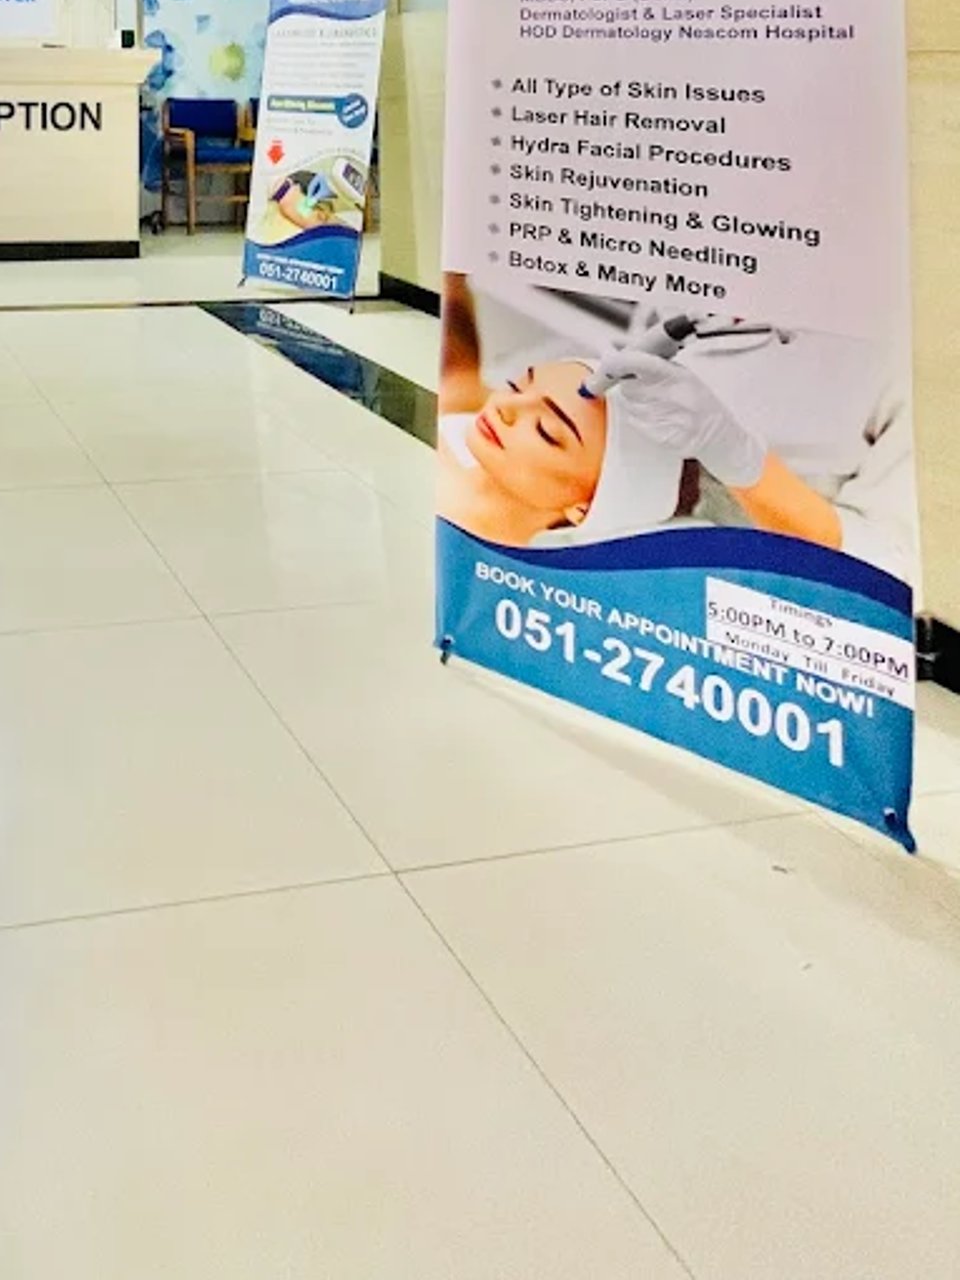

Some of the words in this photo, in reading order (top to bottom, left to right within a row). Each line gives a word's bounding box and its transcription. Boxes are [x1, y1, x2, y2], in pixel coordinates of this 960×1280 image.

[520, 6, 638, 23] Dermatologist
[643, 7, 655, 21] &
[662, 6, 715, 20] Laser
[721, 4, 823, 23] Specialist
[520, 24, 557, 39] HOD
[563, 24, 673, 43] Dermatology
[678, 24, 758, 39] Nescom
[766, 24, 855, 43] Hospital
[511, 78, 537, 95] All
[544, 78, 592, 98] Type
[600, 79, 620, 97] of
[628, 81, 677, 100] Skin
[685, 83, 766, 104] Issues
[512, 106, 567, 125] Laser
[573, 109, 617, 128] Hair
[625, 112, 725, 134] Removal
[510, 135, 570, 157] Hydra
[577, 139, 641, 160] Facial
[650, 144, 792, 172] Procedures
[510, 164, 554, 184] Skin
[561, 168, 708, 198] Rejuvenation
[509, 193, 553, 213] Skin
[561, 197, 678, 231] Tightening
[686, 211, 704, 230] &
[713, 214, 821, 247] Glowing
[509, 222, 552, 242] PRP
[558, 227, 573, 246] &
[580, 231, 642, 254] Micro
[649, 239, 758, 274] Needling
[259, 262, 337, 291] 051-2740001
[509, 251, 568, 276] Botox
[575, 260, 590, 278] &
[598, 265, 657, 293] Many
[666, 272, 726, 300] More
[770, 598, 833, 629] Timings
[475, 561, 536, 598] BOOK
[541, 582, 601, 621] YOUR
[607, 608, 789, 686] APPOINTMENT
[796, 671, 874, 718] NOW!
[708, 601, 786, 638] 5:00PM
[793, 629, 816, 648] to
[824, 636, 909, 679] 7:00PM
[725, 631, 789, 662] Monday
[805, 657, 828, 675] Till
[495, 599, 845, 767] 051-2740001
